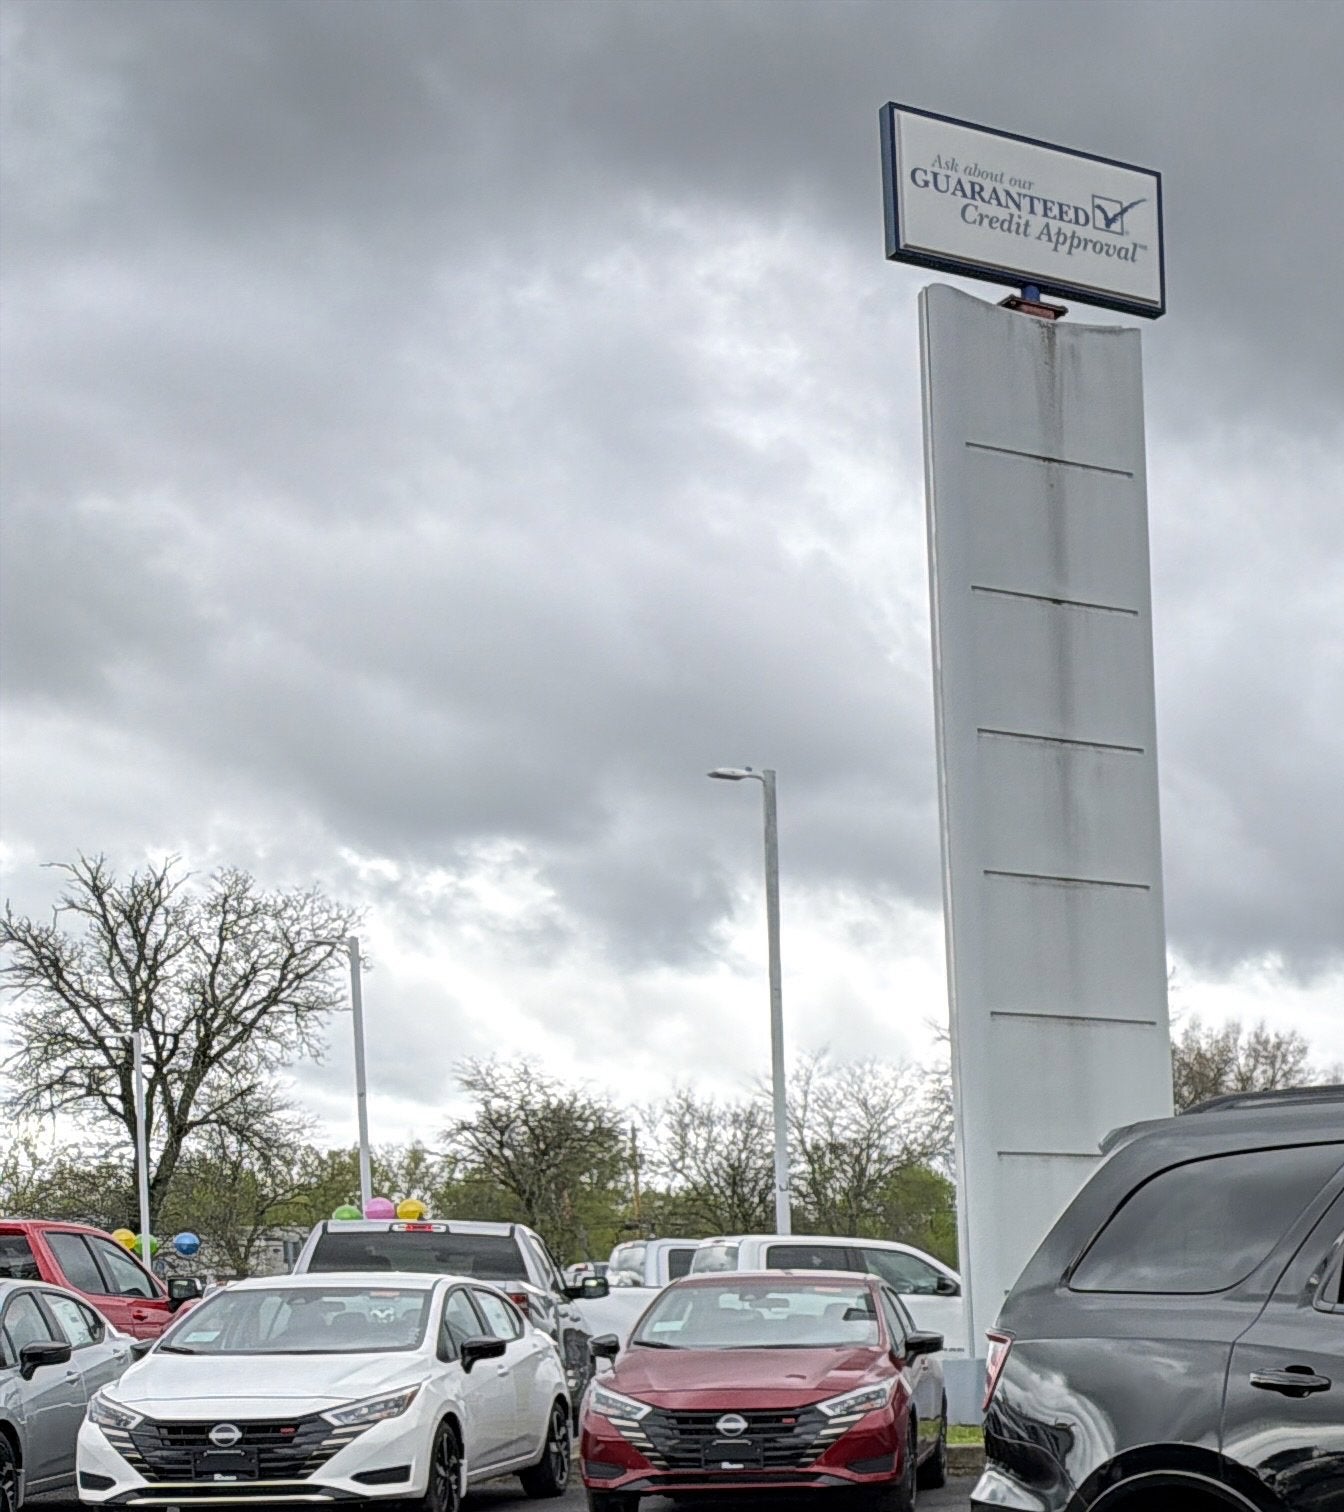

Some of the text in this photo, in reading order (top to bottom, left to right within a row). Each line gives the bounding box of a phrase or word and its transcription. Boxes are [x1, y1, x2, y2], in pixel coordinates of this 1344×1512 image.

[931, 154, 1035, 191] Ask about our
[910, 166, 1090, 228] GUARANTEED
[960, 202, 1031, 237] Credit
